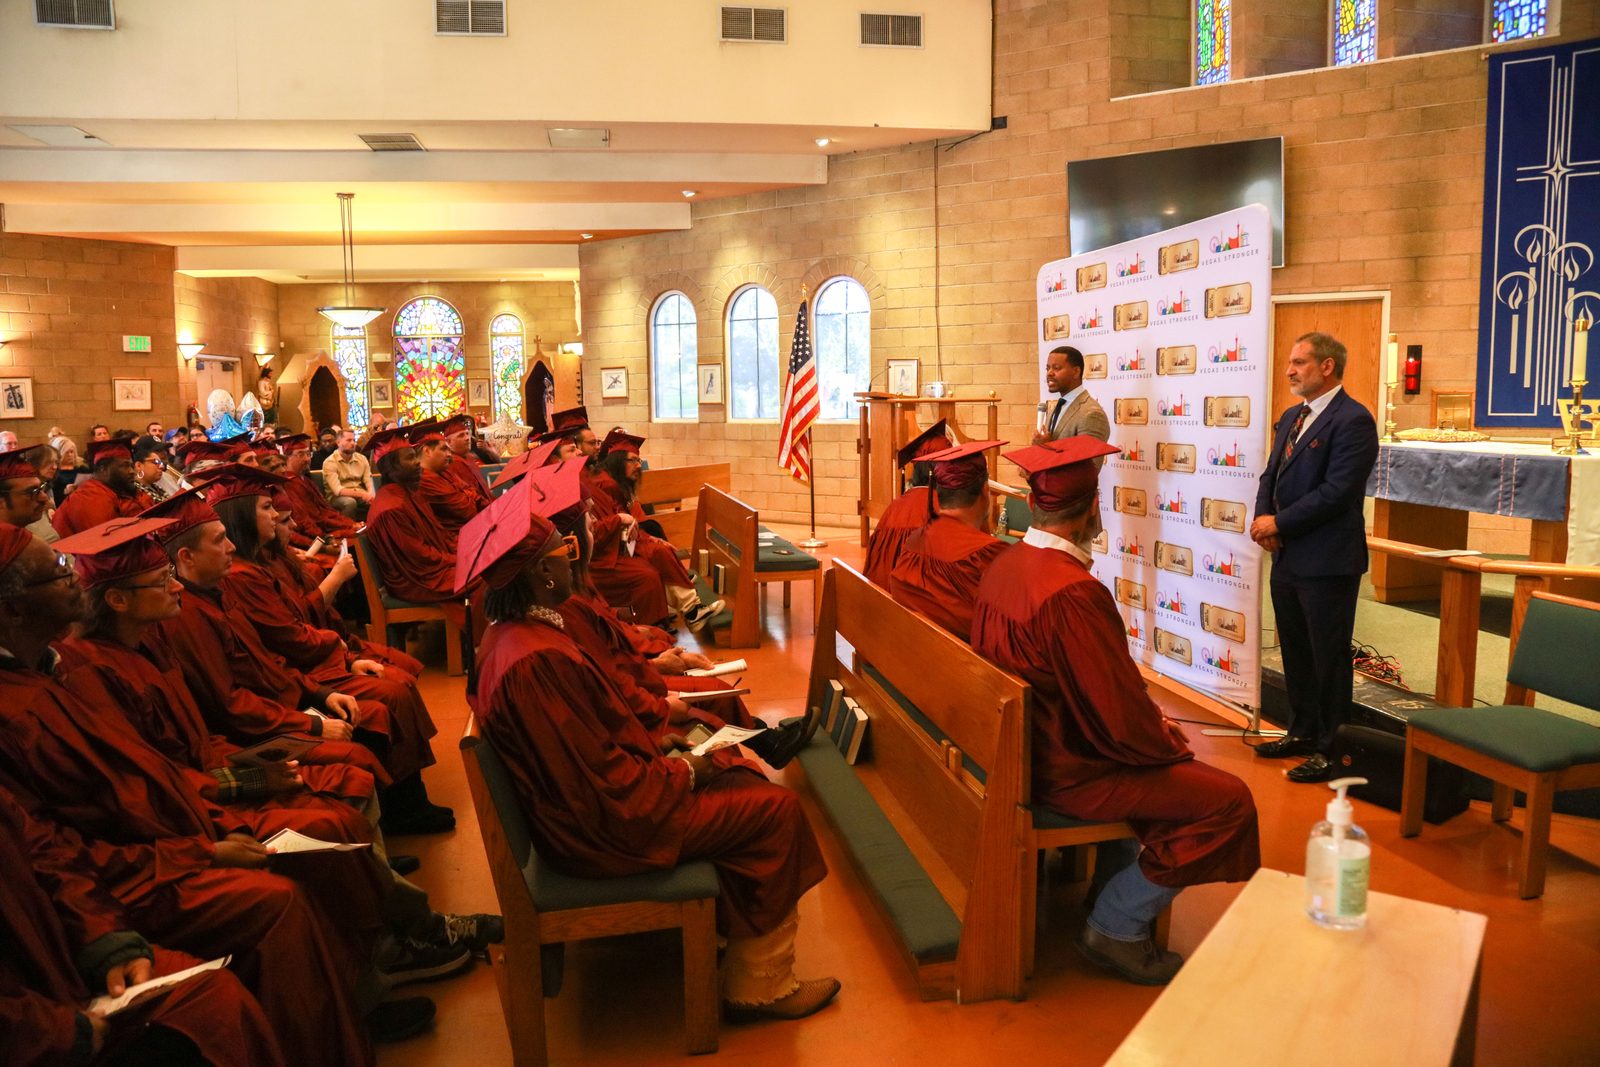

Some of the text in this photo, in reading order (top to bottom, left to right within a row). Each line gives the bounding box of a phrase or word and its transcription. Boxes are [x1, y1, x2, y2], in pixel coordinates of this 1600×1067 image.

[1201, 257, 1221, 266] VEGAS
[1224, 248, 1260, 261] STRONGER
[1110, 274, 1153, 288] VEGAS STRONGER
[1169, 314, 1199, 324] STRONGER
[129, 336, 147, 351] EXIT
[1222, 365, 1257, 373] STRONGER
[1126, 372, 1153, 380] STRONGER
[1199, 468, 1255, 478] VEGAS STRONGER
[1166, 515, 1196, 525] STRONGER
[1196, 573, 1250, 590] VEGAS STRONGER
[1148, 609, 1164, 617] VEGAS
[1166, 613, 1196, 627] STRONGER
[1128, 639, 1152, 651] TRONGER
[1194, 664, 1248, 688] VEGAS STRONGER
